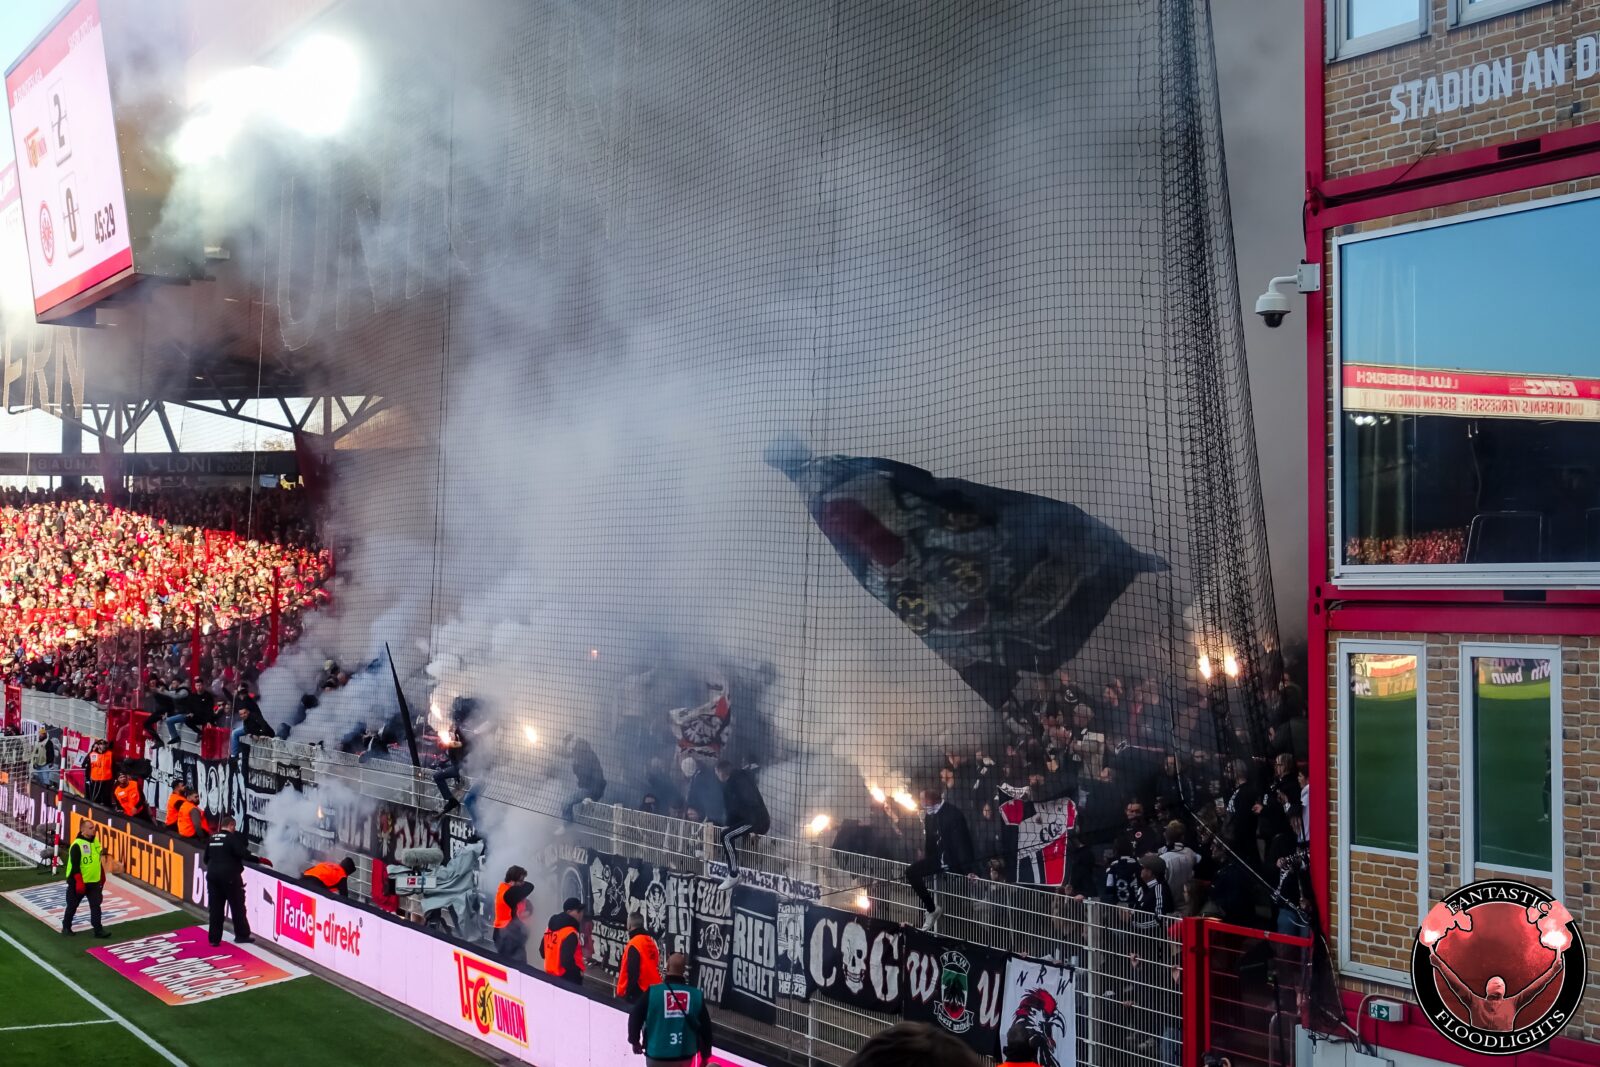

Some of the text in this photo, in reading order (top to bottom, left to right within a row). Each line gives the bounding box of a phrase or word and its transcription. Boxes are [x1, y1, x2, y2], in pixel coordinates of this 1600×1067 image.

[1390, 34, 1600, 124] STADION AN D
[53, 93, 66, 150] 2
[65, 186, 78, 242] 0
[94, 203, 116, 244] 45:29
[733, 912, 775, 969] RIED
[733, 959, 776, 1000] GEBIET
[493, 993, 527, 1043] UNION
